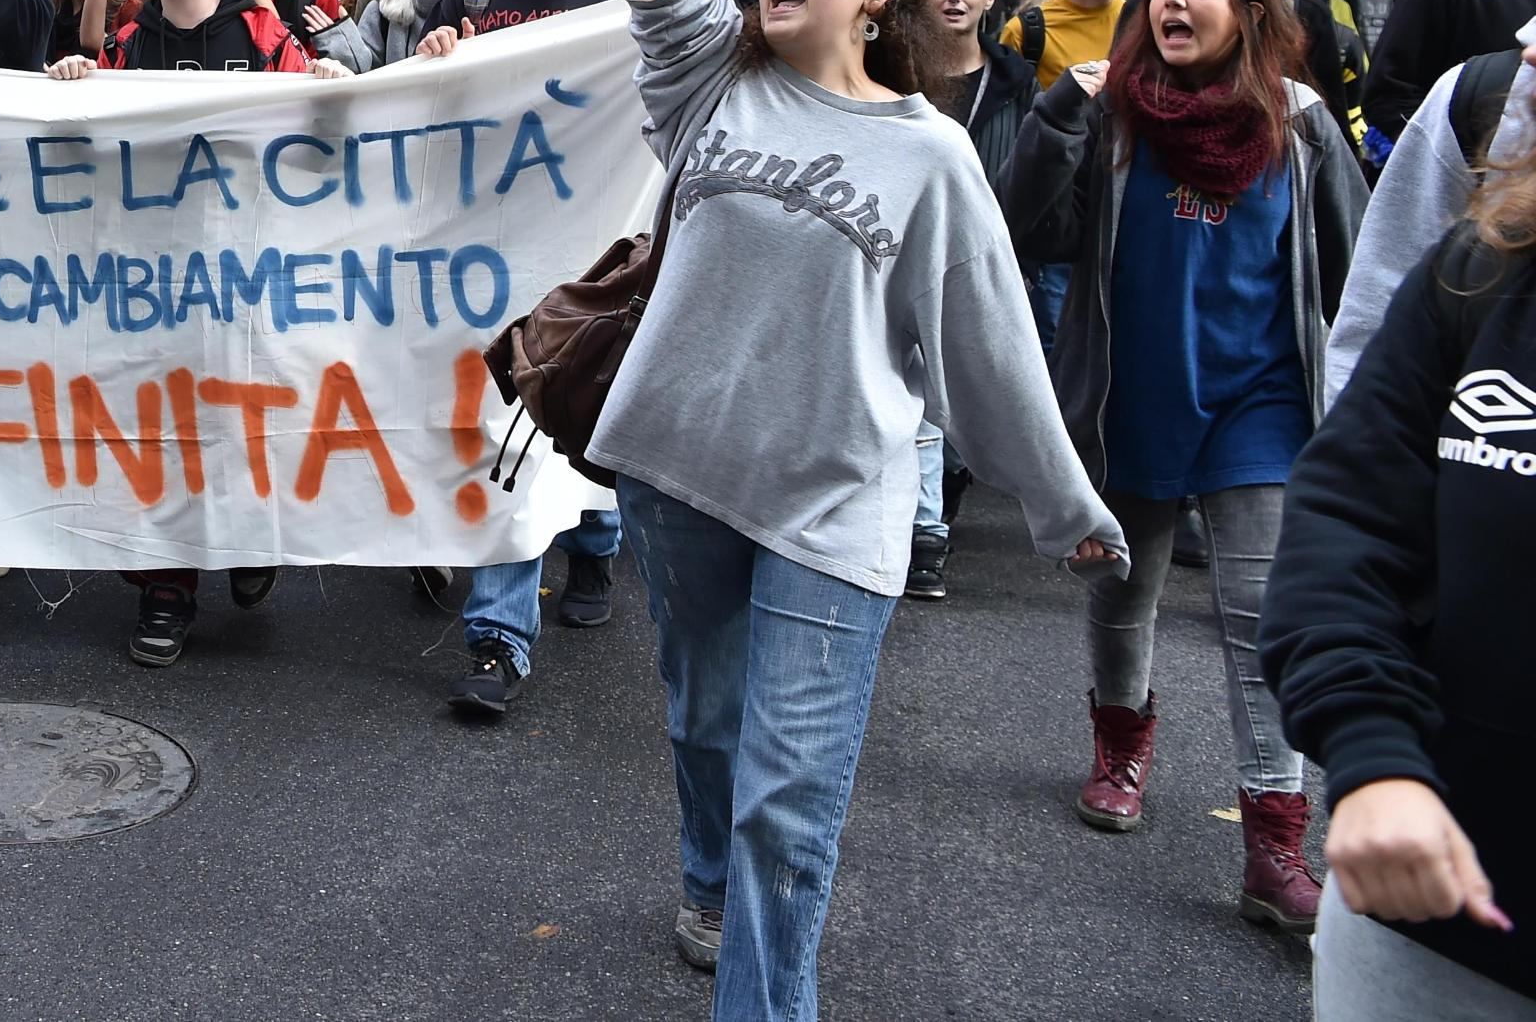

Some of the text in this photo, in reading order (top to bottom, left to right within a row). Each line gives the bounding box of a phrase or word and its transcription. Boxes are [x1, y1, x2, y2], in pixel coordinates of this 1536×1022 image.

[27, 135, 97, 215] E
[119, 133, 240, 211] LA
[262, 78, 592, 210] CITTÀ
